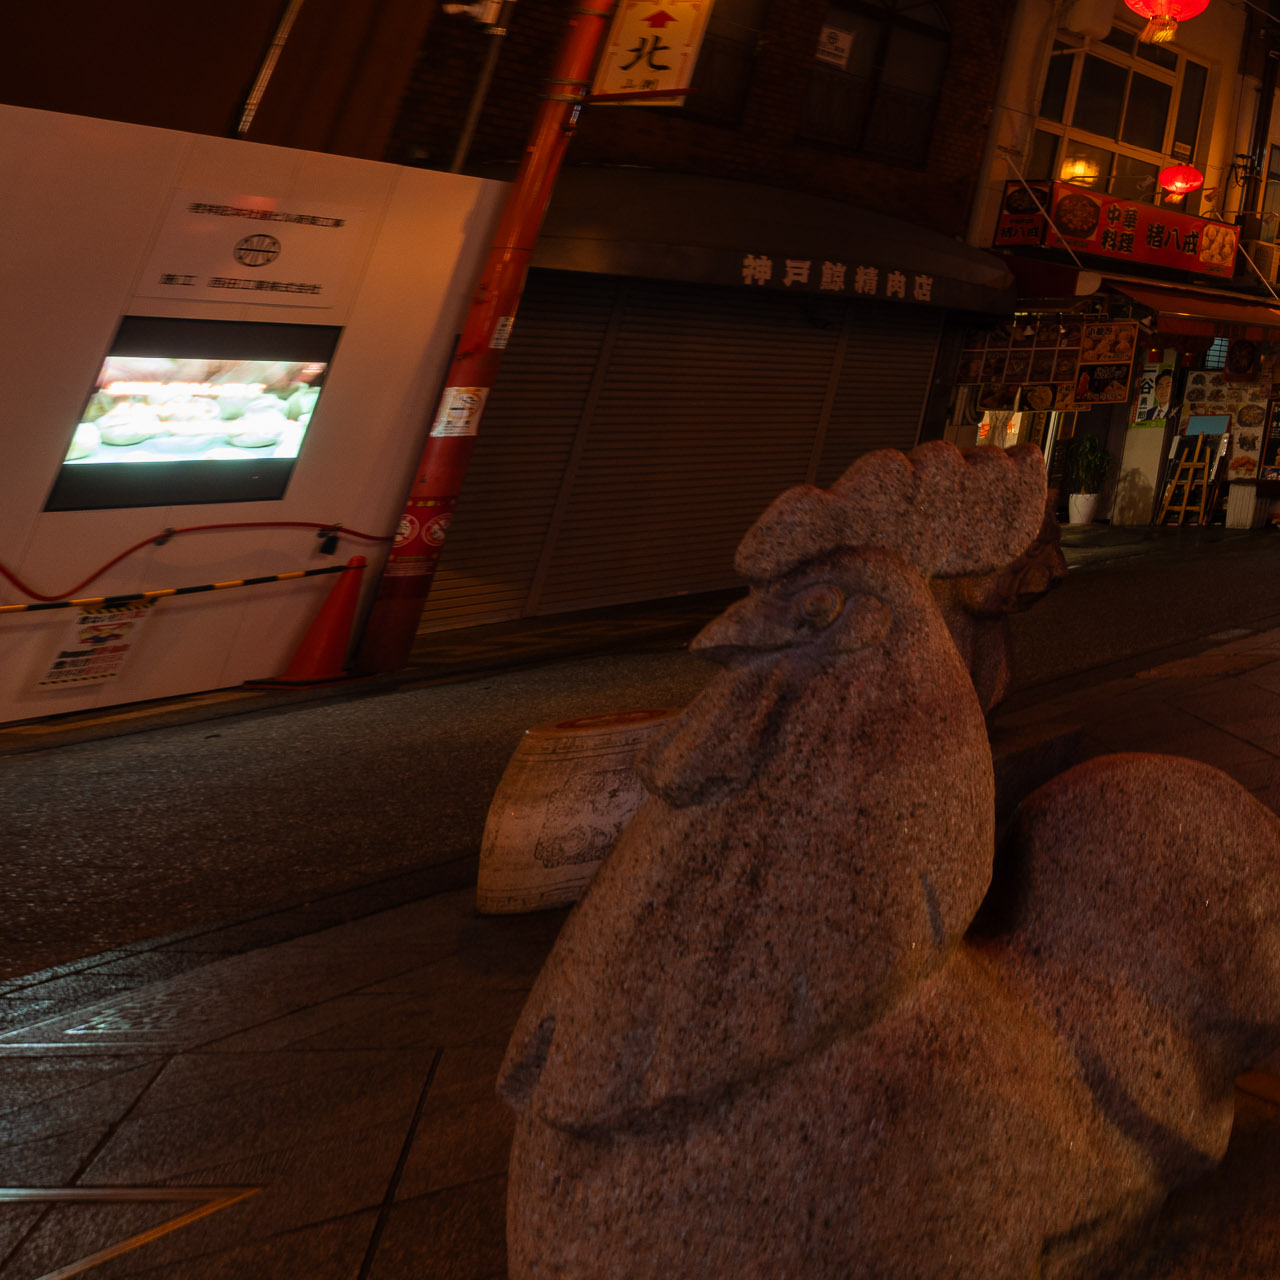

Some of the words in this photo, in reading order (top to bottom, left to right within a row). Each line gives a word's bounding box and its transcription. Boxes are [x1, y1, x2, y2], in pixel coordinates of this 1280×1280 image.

[620, 34, 671, 71] 北
[1106, 203, 1139, 228] 中華
[1101, 227, 1136, 254] 料理
